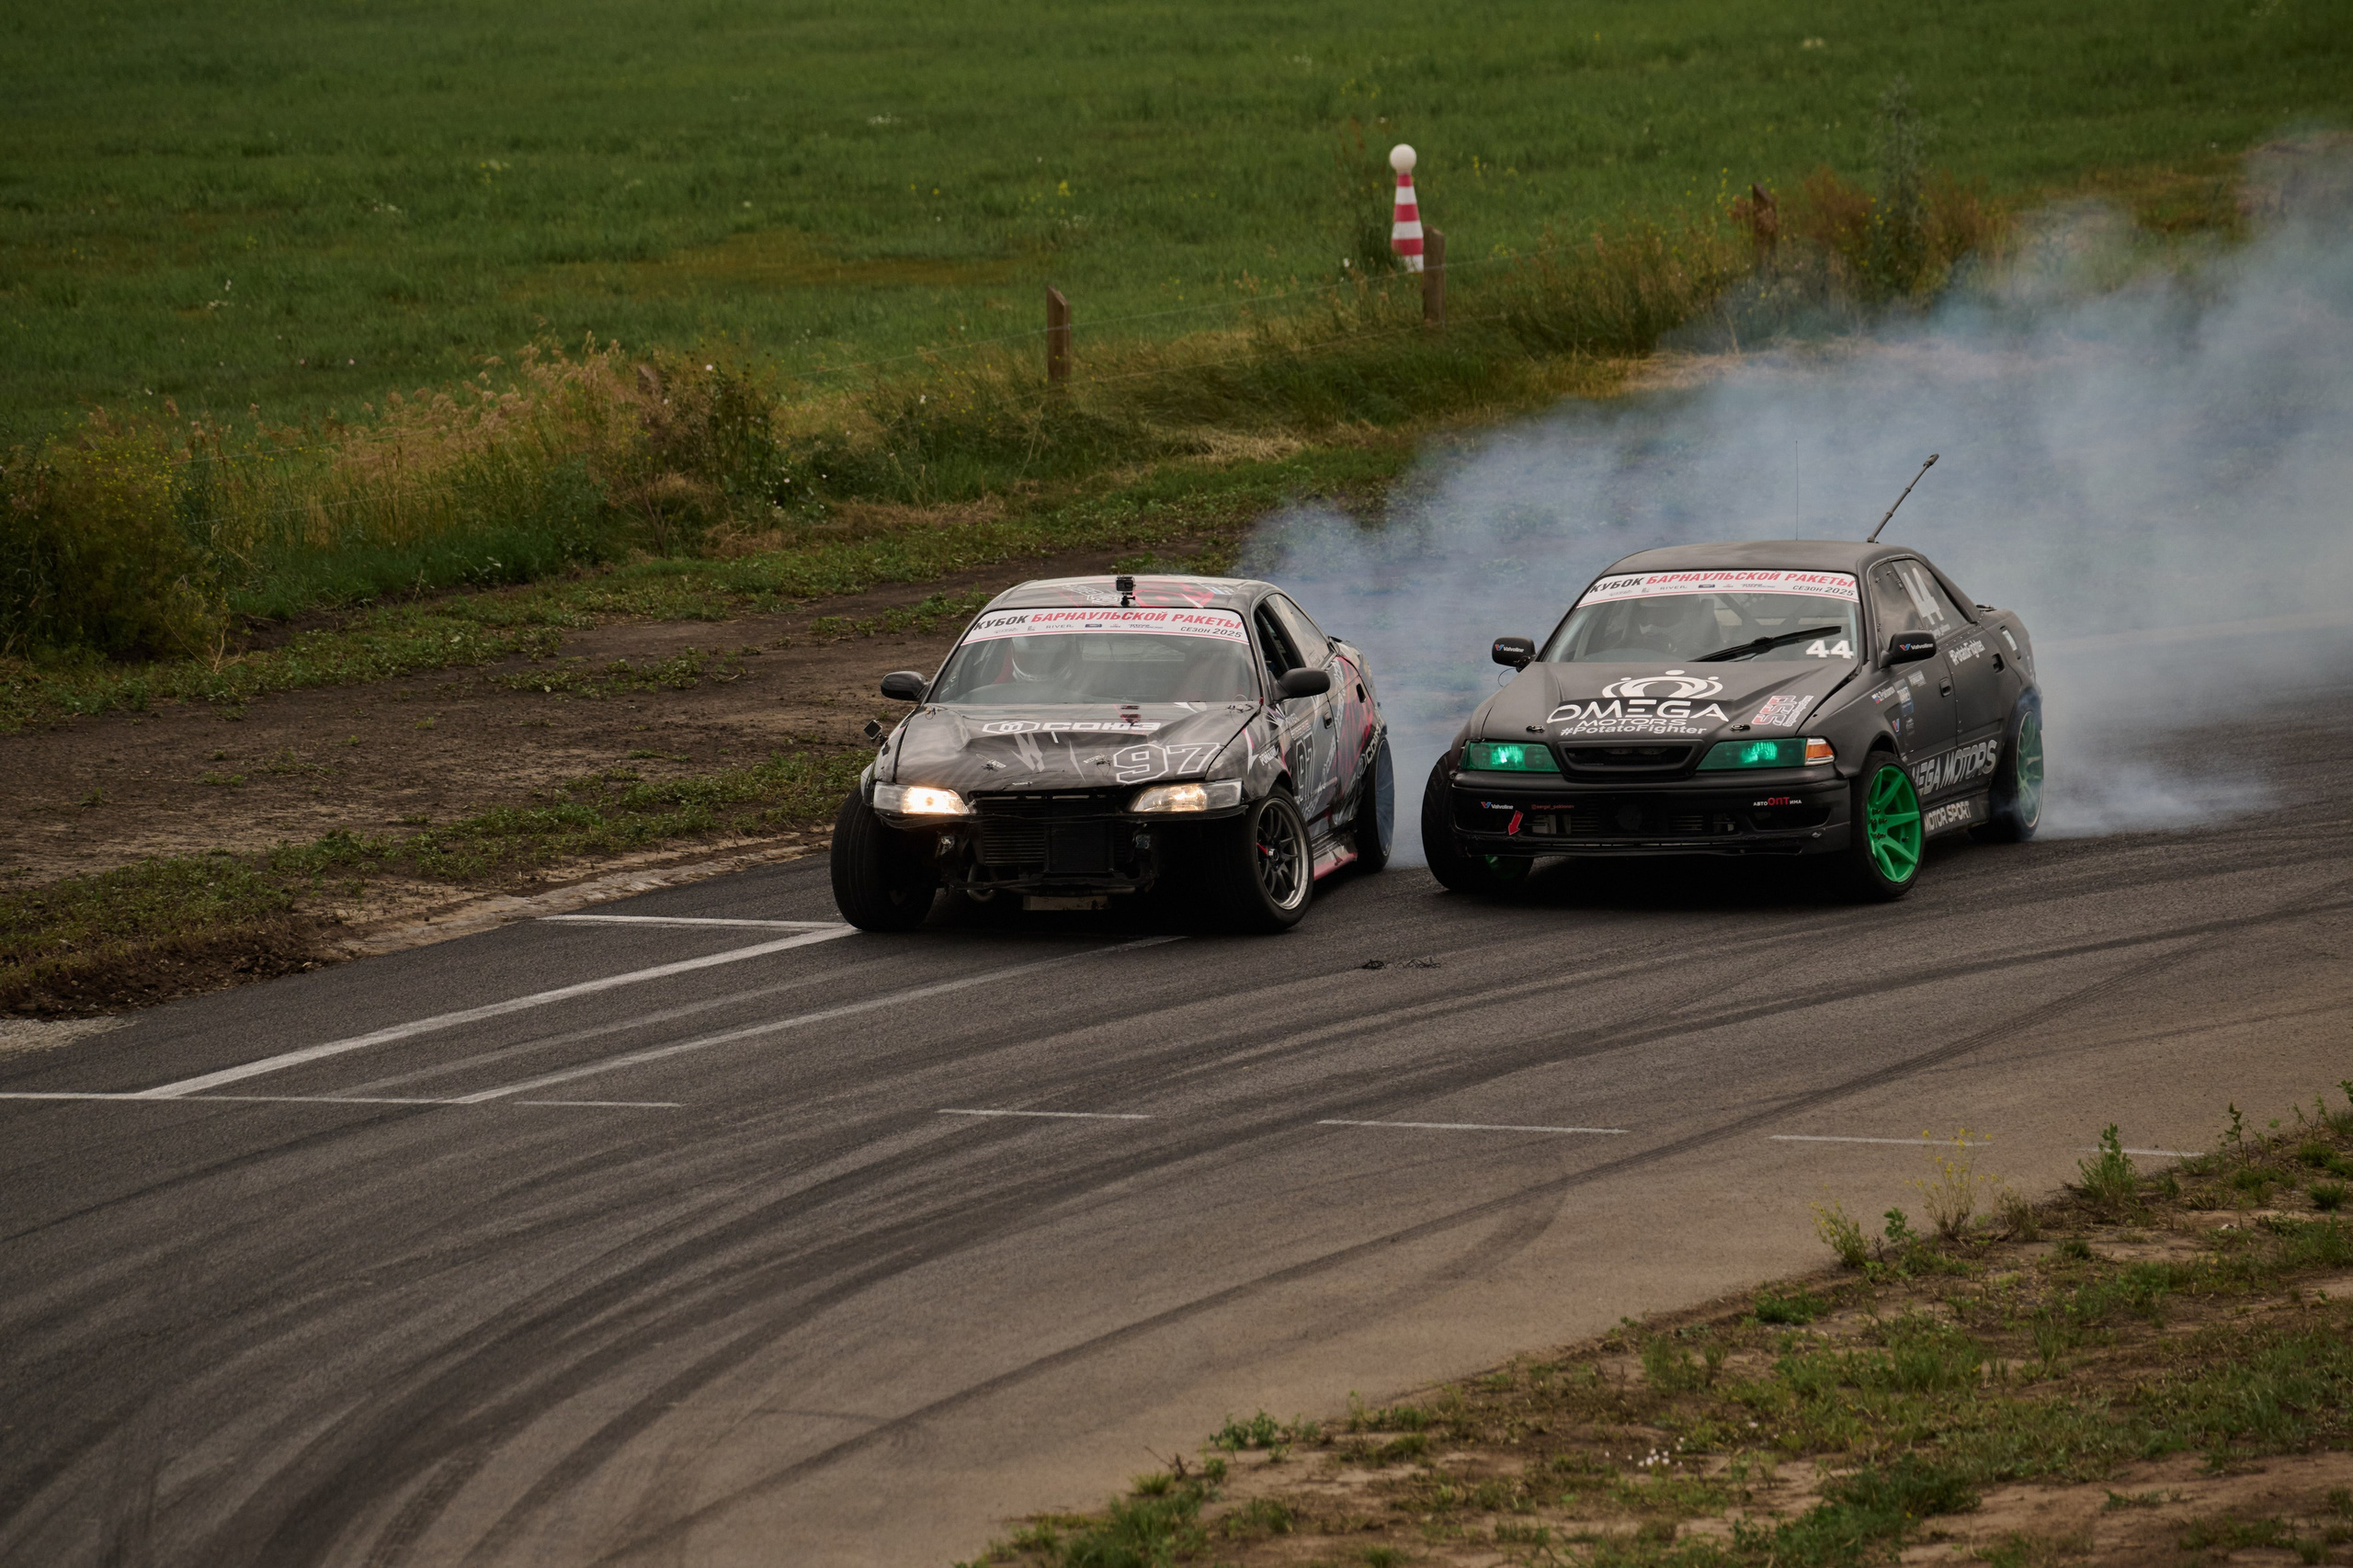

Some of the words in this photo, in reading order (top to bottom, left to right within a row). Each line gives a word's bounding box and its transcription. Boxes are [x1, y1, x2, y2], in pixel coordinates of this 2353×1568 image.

[1589, 576, 1645, 593] КУБОК
[1645, 571, 1781, 584] БАРНАУЛЬСКОЙ
[1784, 573, 1856, 587] РАКЕТЫ
[1824, 586, 1855, 596] 2025
[973, 615, 1029, 631] КУБОК
[1030, 610, 1168, 623] БАРНАУЛЬСКОЙ
[1171, 613, 1242, 629] РАКЕТЫ
[1212, 629, 1243, 637] 2025
[1805, 640, 1854, 659] 44
[1546, 699, 1729, 723] OMEGA
[1560, 724, 1707, 735] #PotatoFighter
[1577, 718, 1687, 727] MOTORS
[1112, 742, 1221, 784] 97
[1940, 739, 1997, 788] MOTORS
[1924, 807, 1948, 833] MOTOR
[1946, 801, 1972, 823] SPORT
